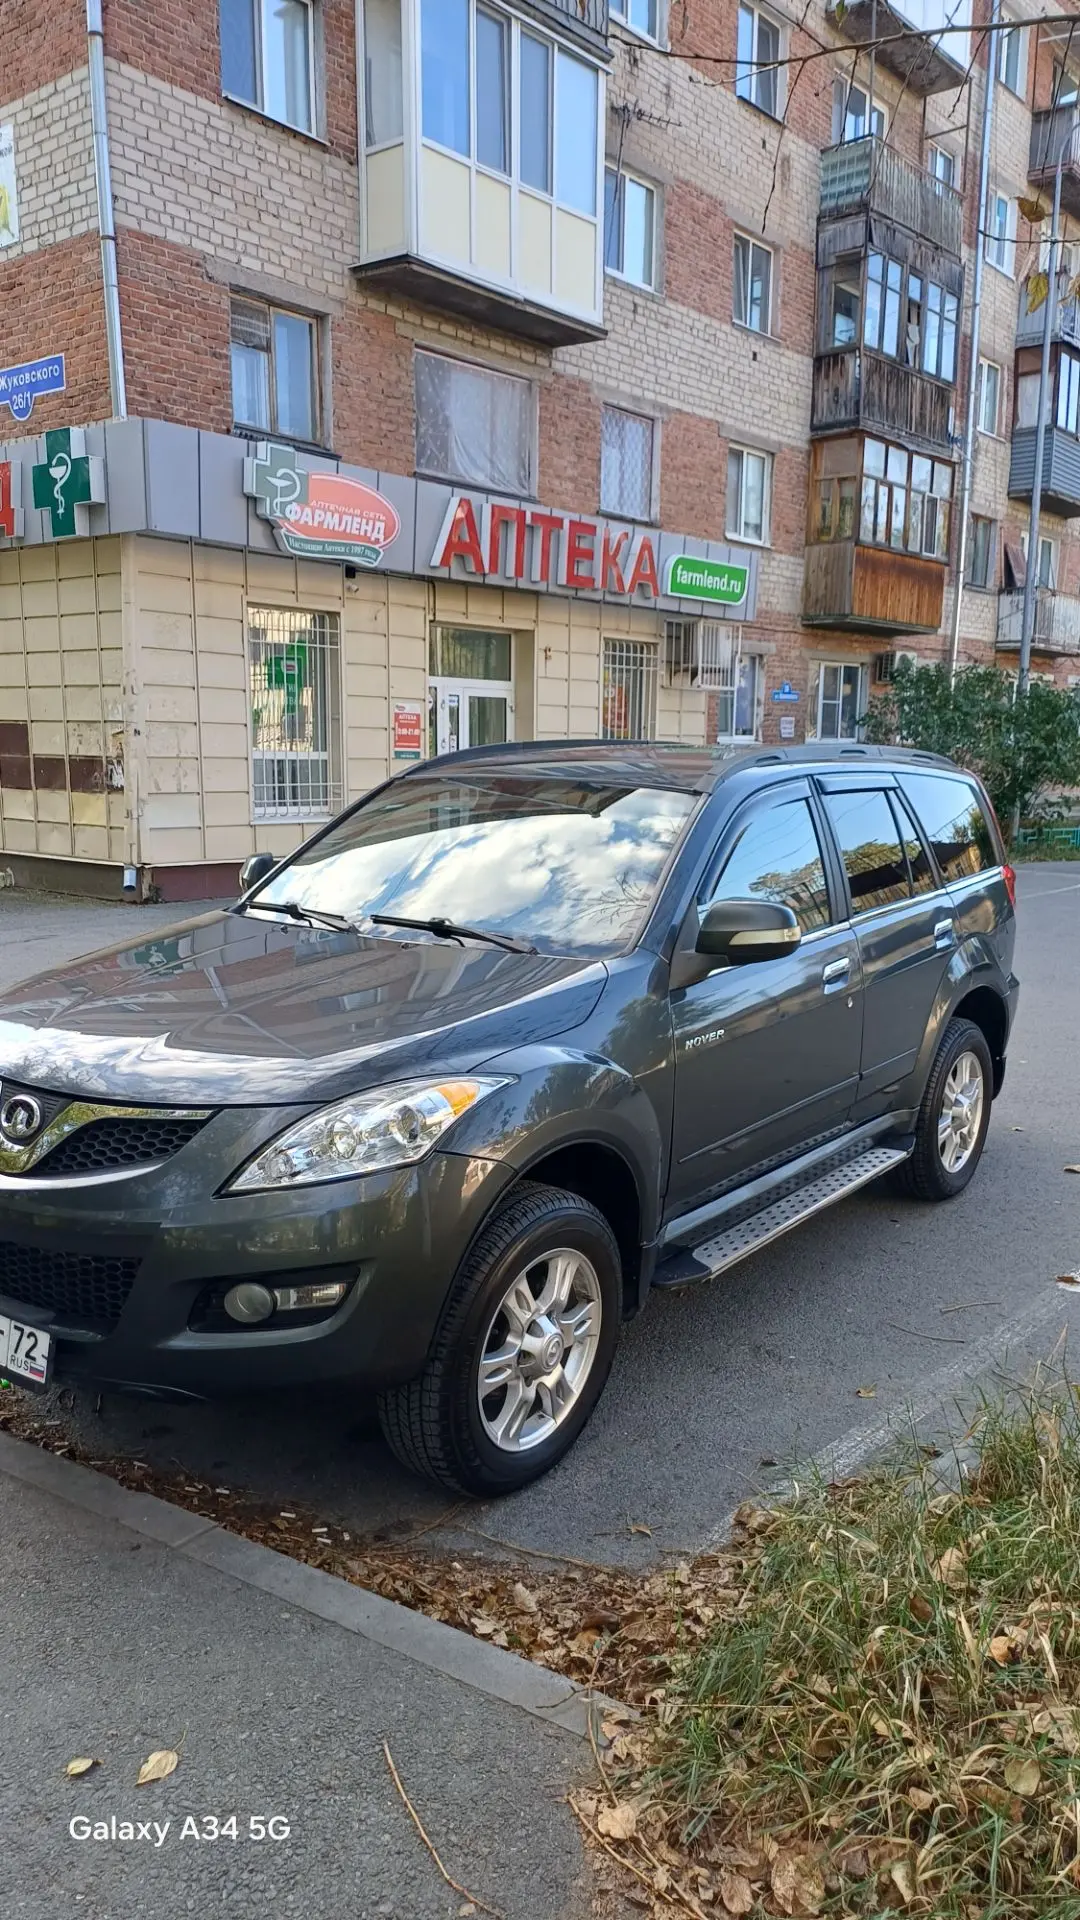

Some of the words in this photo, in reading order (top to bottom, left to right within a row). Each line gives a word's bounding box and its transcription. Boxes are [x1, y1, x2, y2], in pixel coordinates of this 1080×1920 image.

[0, 364, 60, 392] Жуковского
[12, 391, 31, 410] 26/1
[285, 502, 386, 545] ФАРМЛЕНД
[310, 500, 361, 517] АПТЕЧНАЯ
[363, 510, 386, 520] СЕТЬ
[438, 497, 660, 598] АПТЕКА
[677, 564, 741, 593] farmlend.ru
[685, 1029, 725, 1050] HOVER
[13, 1324, 38, 1362] 72
[9, 1354, 29, 1371] RUS
